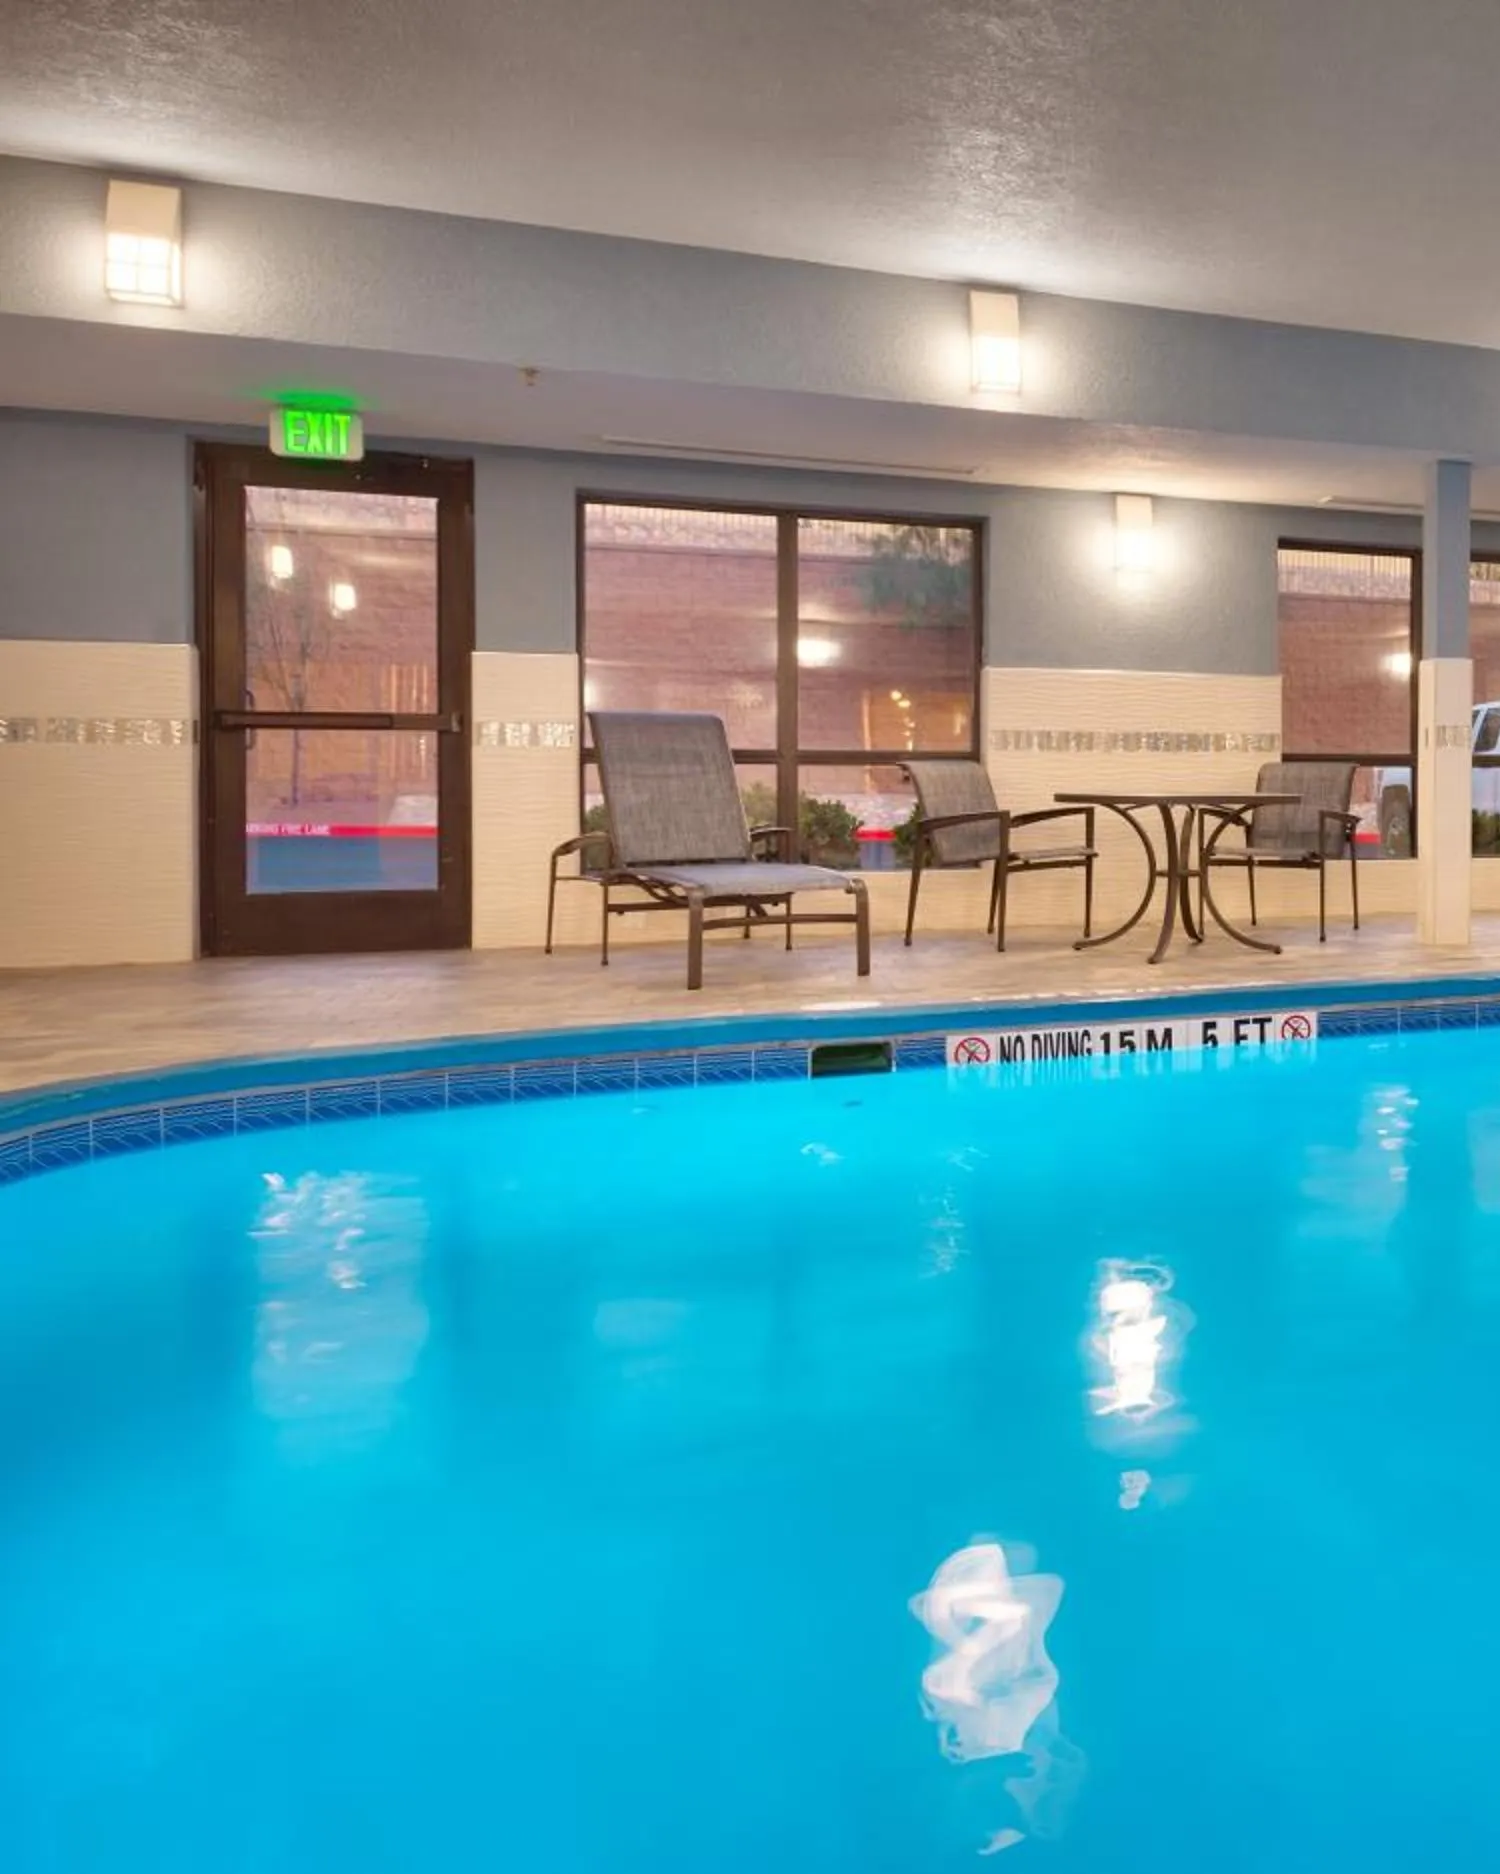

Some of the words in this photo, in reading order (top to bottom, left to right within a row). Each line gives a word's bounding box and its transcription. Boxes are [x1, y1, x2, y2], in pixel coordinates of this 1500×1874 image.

[284, 411, 351, 456] EXIT
[1000, 1035, 1025, 1063] NO
[1031, 1029, 1092, 1060] DIVING
[1201, 1021, 1219, 1049] 5
[1233, 1016, 1273, 1046] FT
